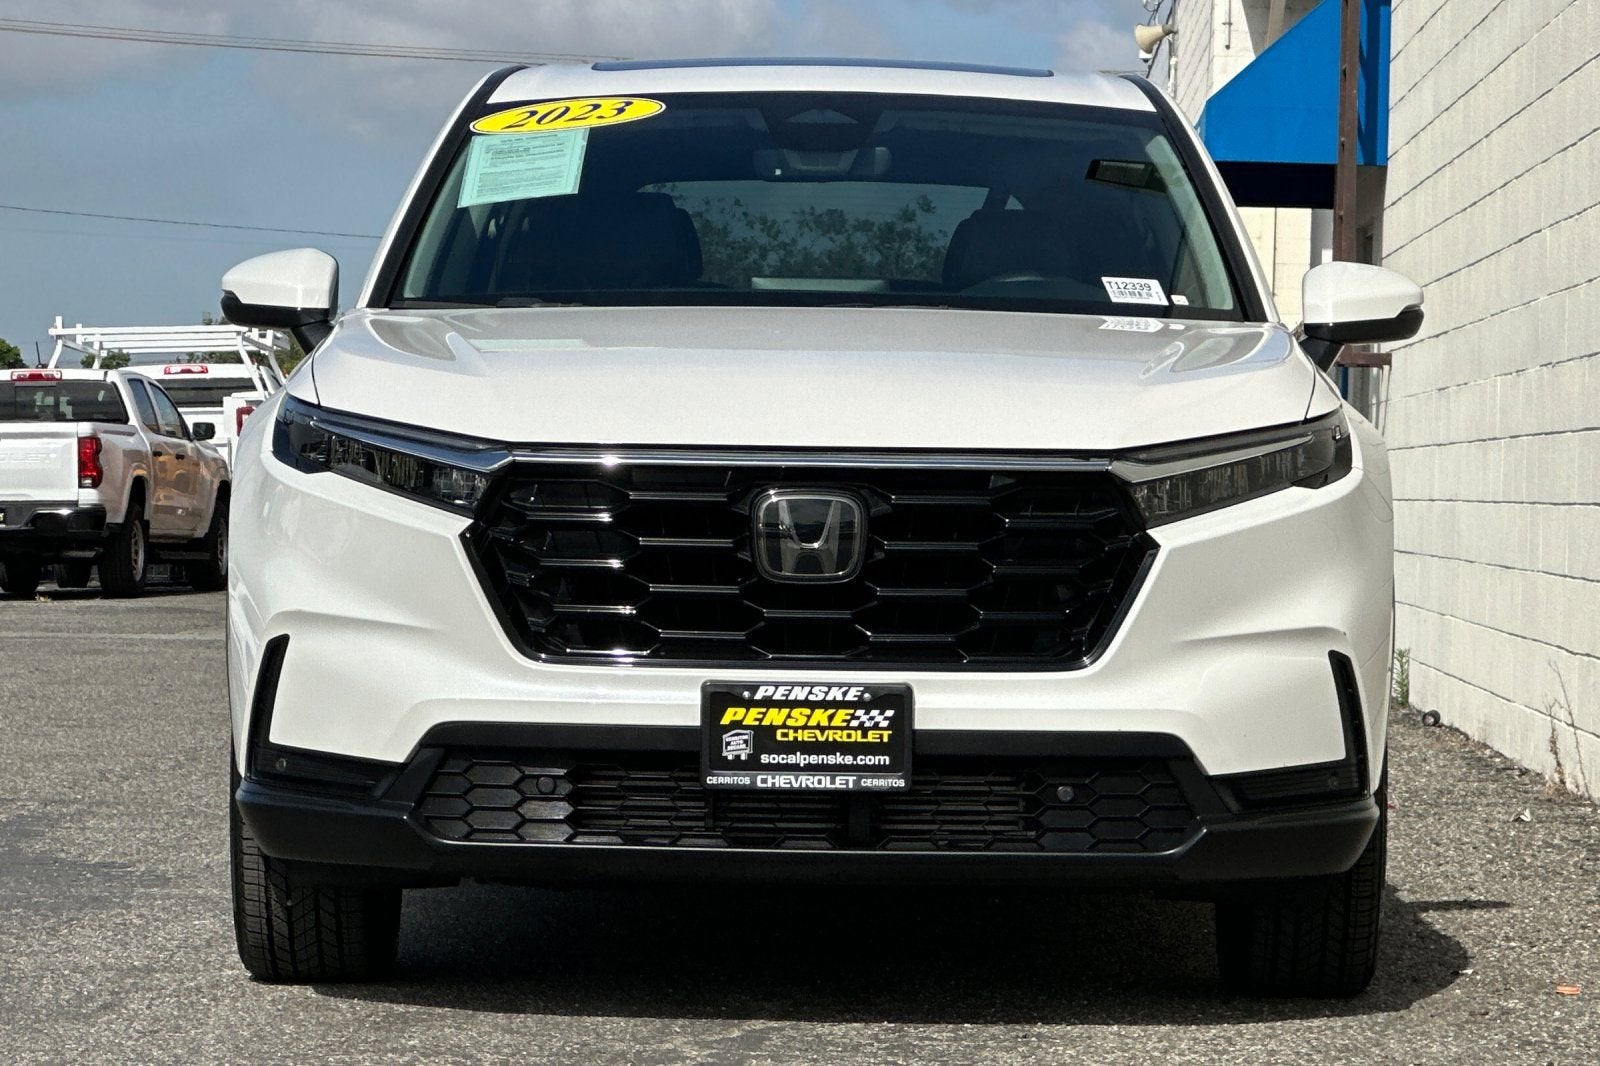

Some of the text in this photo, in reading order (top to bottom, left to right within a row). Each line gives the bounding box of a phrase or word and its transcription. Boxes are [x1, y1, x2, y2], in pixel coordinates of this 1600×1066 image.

[501, 101, 634, 130] 2023
[1106, 281, 1152, 291] T12339
[754, 685, 865, 701] PENSKE
[719, 707, 854, 726] PENSKE
[776, 728, 893, 743] CHEVROLET
[760, 751, 890, 767] socalpenske.com
[706, 774, 905, 789] CERRITOS CHEVROLET CERRITOS
